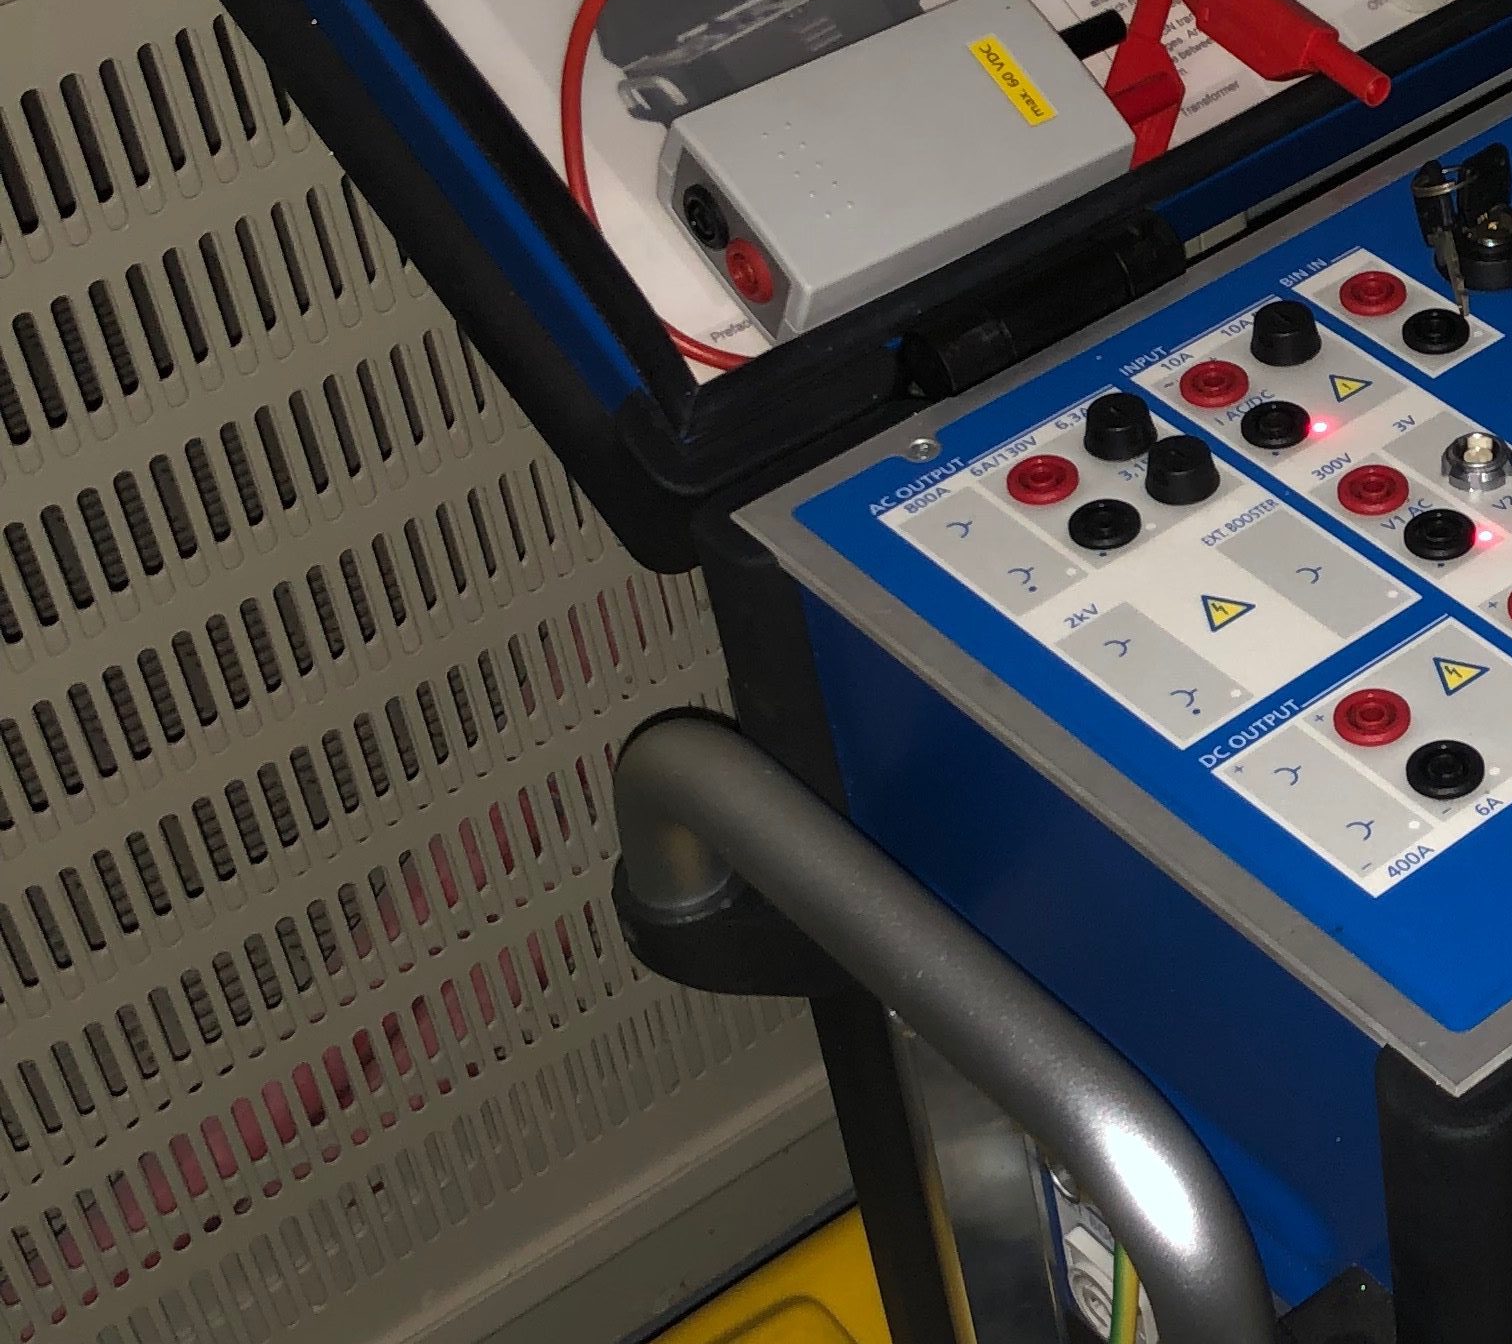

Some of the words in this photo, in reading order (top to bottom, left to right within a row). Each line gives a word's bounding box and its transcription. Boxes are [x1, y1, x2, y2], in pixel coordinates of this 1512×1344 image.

[979, 44, 1004, 71] VDC
[1279, 268, 1308, 288] BIN
[1307, 258, 1328, 276] IN
[1119, 346, 1170, 377] INPUT
[1160, 353, 1194, 371] 10A
[1392, 416, 1416, 432] 3V
[970, 435, 1038, 477] 6A/130V
[1311, 453, 1352, 480] 300V
[869, 495, 891, 517] AC
[895, 456, 967, 501] OUTPUT
[903, 486, 951, 514] 800A
[1228, 498, 1280, 534] BOOSTER
[1381, 513, 1406, 532] V1
[1063, 603, 1099, 629] 2kV
[1198, 745, 1230, 768] DC
[1228, 698, 1302, 750] OUTPUT
[1475, 796, 1504, 816] 6A
[1387, 844, 1435, 880] 400A
